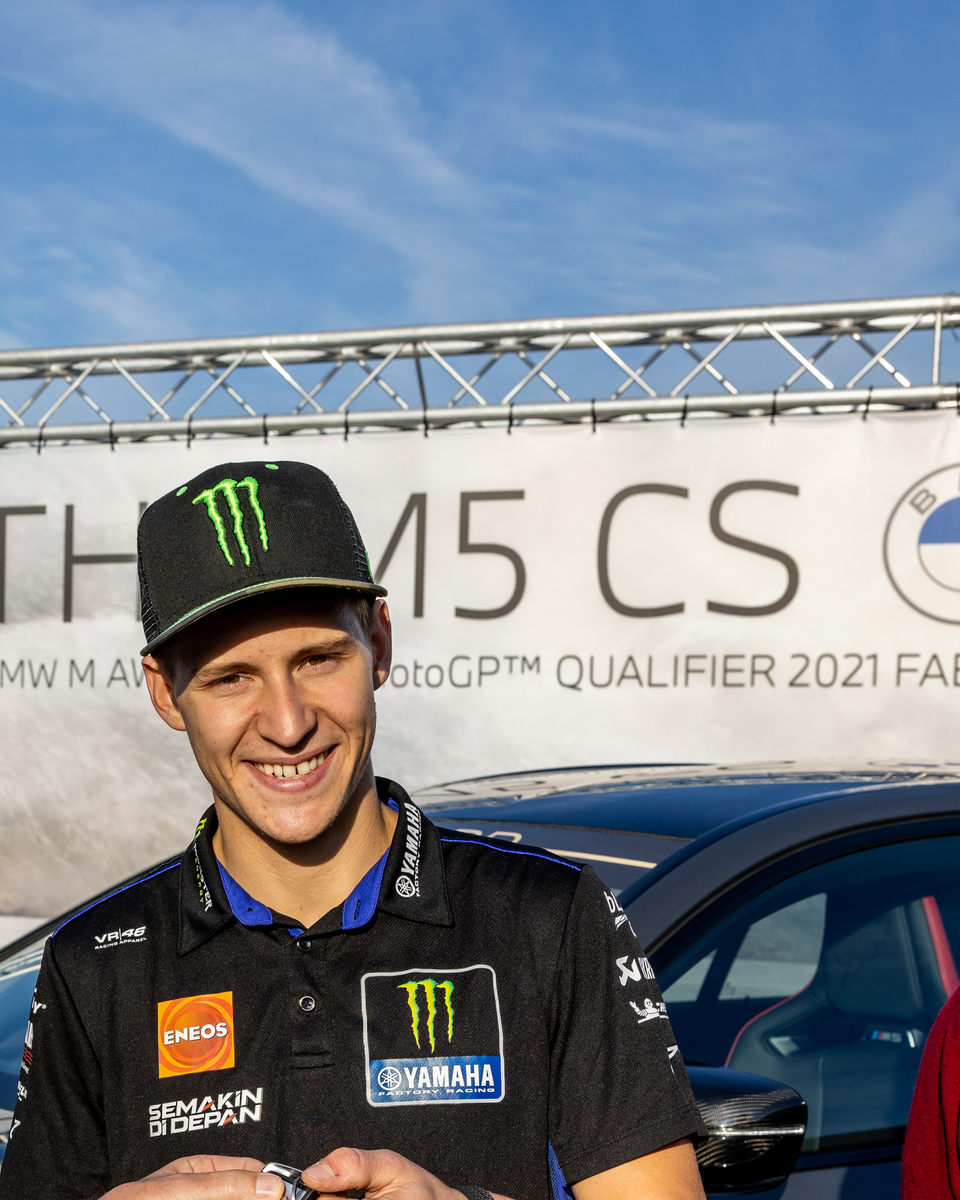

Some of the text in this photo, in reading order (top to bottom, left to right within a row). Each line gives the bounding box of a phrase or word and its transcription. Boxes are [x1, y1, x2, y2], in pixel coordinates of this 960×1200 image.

[597, 480, 800, 618] CS
[69, 658, 95, 688] M
[556, 653, 776, 691] QUALIFIER
[788, 652, 878, 688] 2021
[400, 802, 421, 876] YAMAHA
[164, 1022, 229, 1046] ENEOS
[404, 1064, 495, 1089] YAMAHA
[378, 1089, 440, 1097] FACTORY
[170, 1104, 262, 1134] DEPAN
